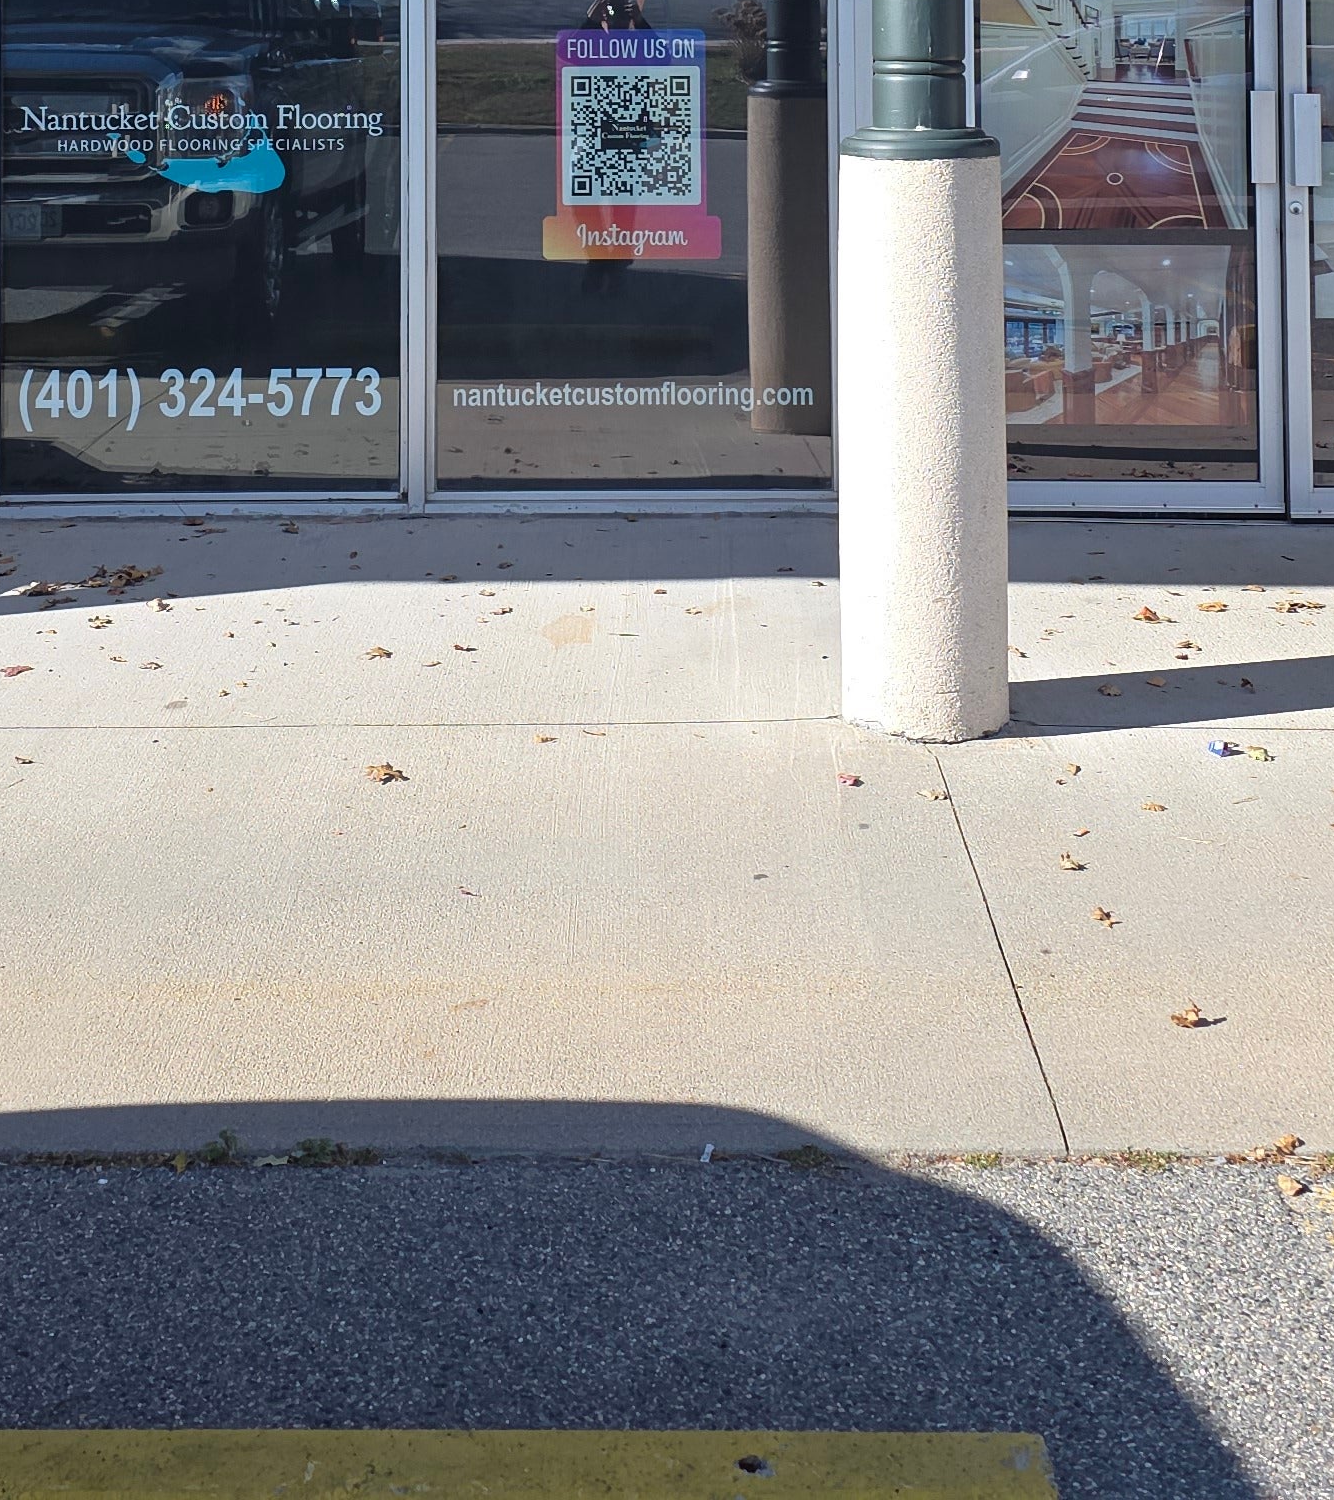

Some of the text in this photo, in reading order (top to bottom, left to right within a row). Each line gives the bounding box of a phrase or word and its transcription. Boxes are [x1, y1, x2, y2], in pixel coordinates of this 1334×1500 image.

[567, 39, 695, 59] FOLLOW US ON
[21, 103, 384, 138] Nantucket Custom Flooring
[57, 138, 345, 152] HARDWOOD FLOORING SPECIALISTS
[576, 223, 688, 256] Instagram
[20, 367, 383, 431] (401) 324-5773
[453, 383, 814, 411] nantucketcustomflooring.com
